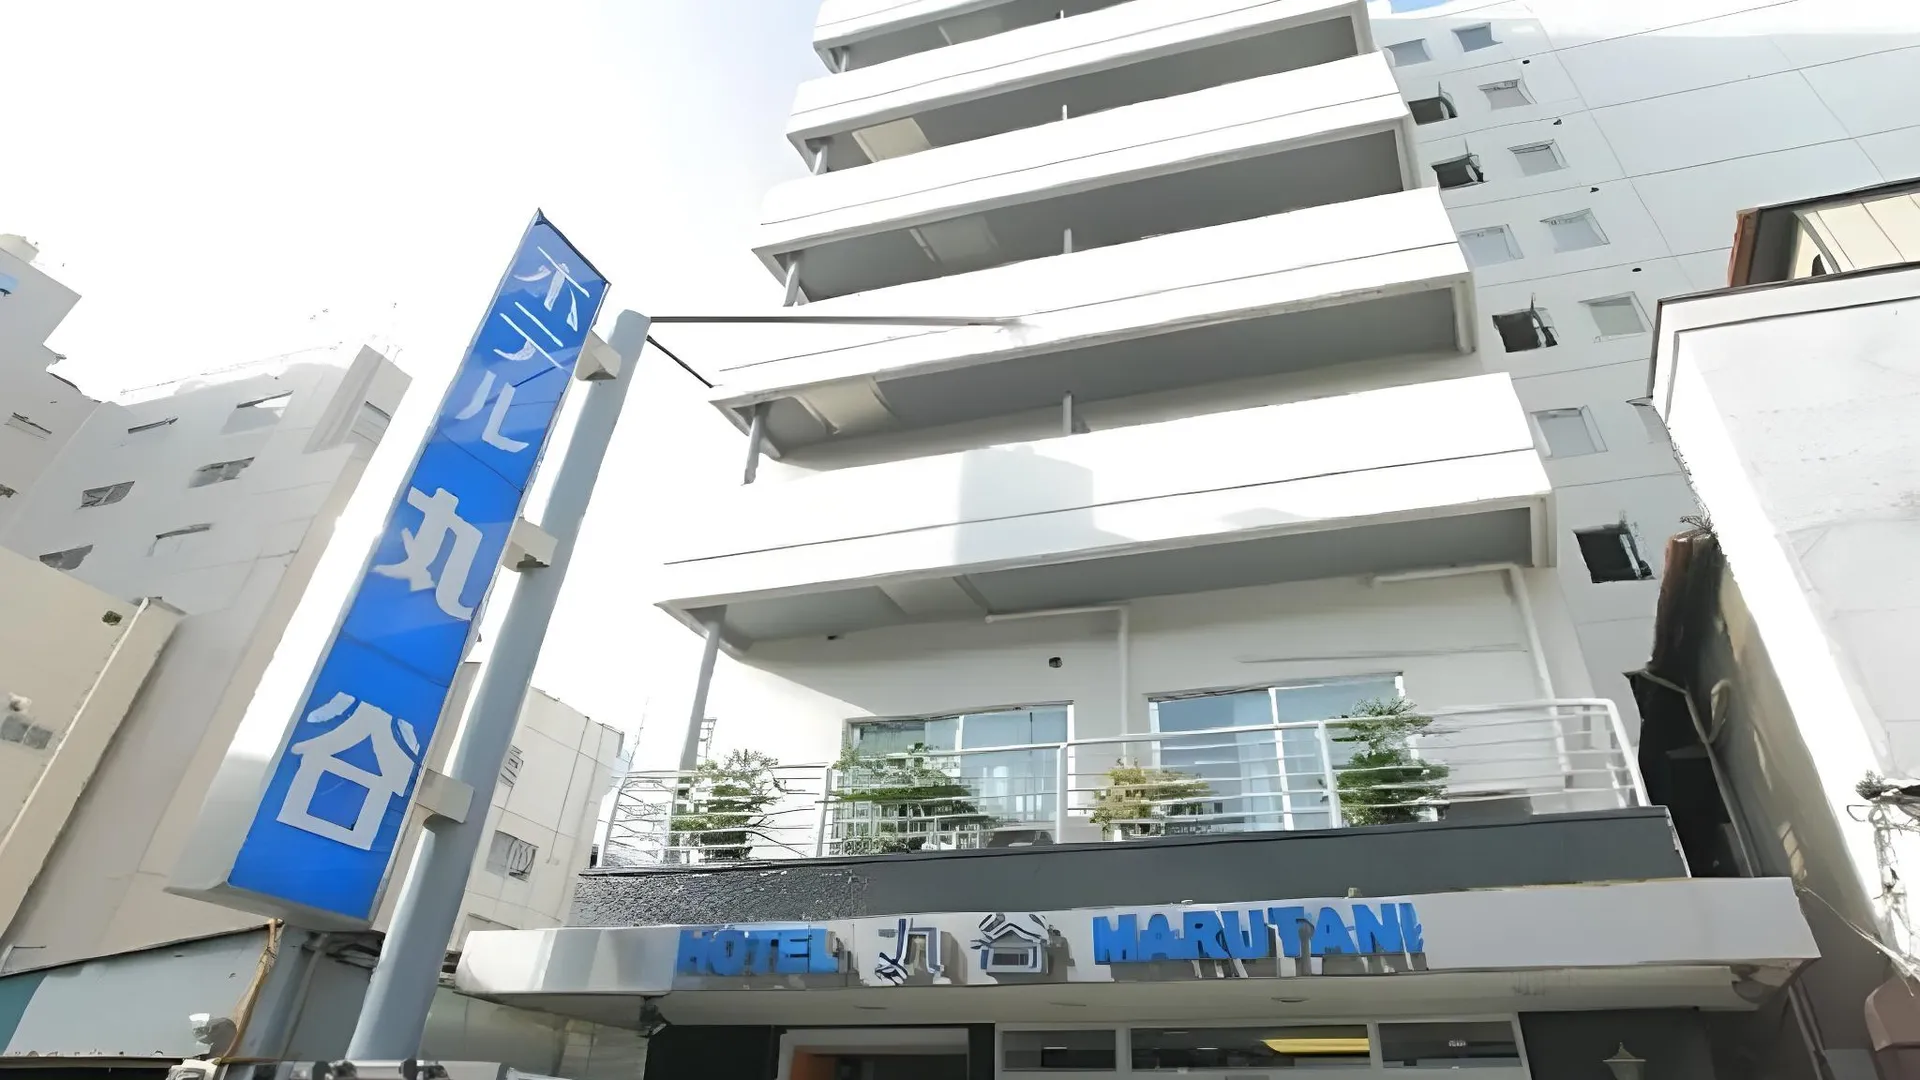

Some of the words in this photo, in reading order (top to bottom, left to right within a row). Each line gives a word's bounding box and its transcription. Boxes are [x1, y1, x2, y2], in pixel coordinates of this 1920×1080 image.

[277, 245, 590, 851] ホテル丸谷
[677, 928, 840, 975] HOTEL
[875, 913, 1049, 985] 丸谷
[1092, 902, 1425, 966] MARUTANI
